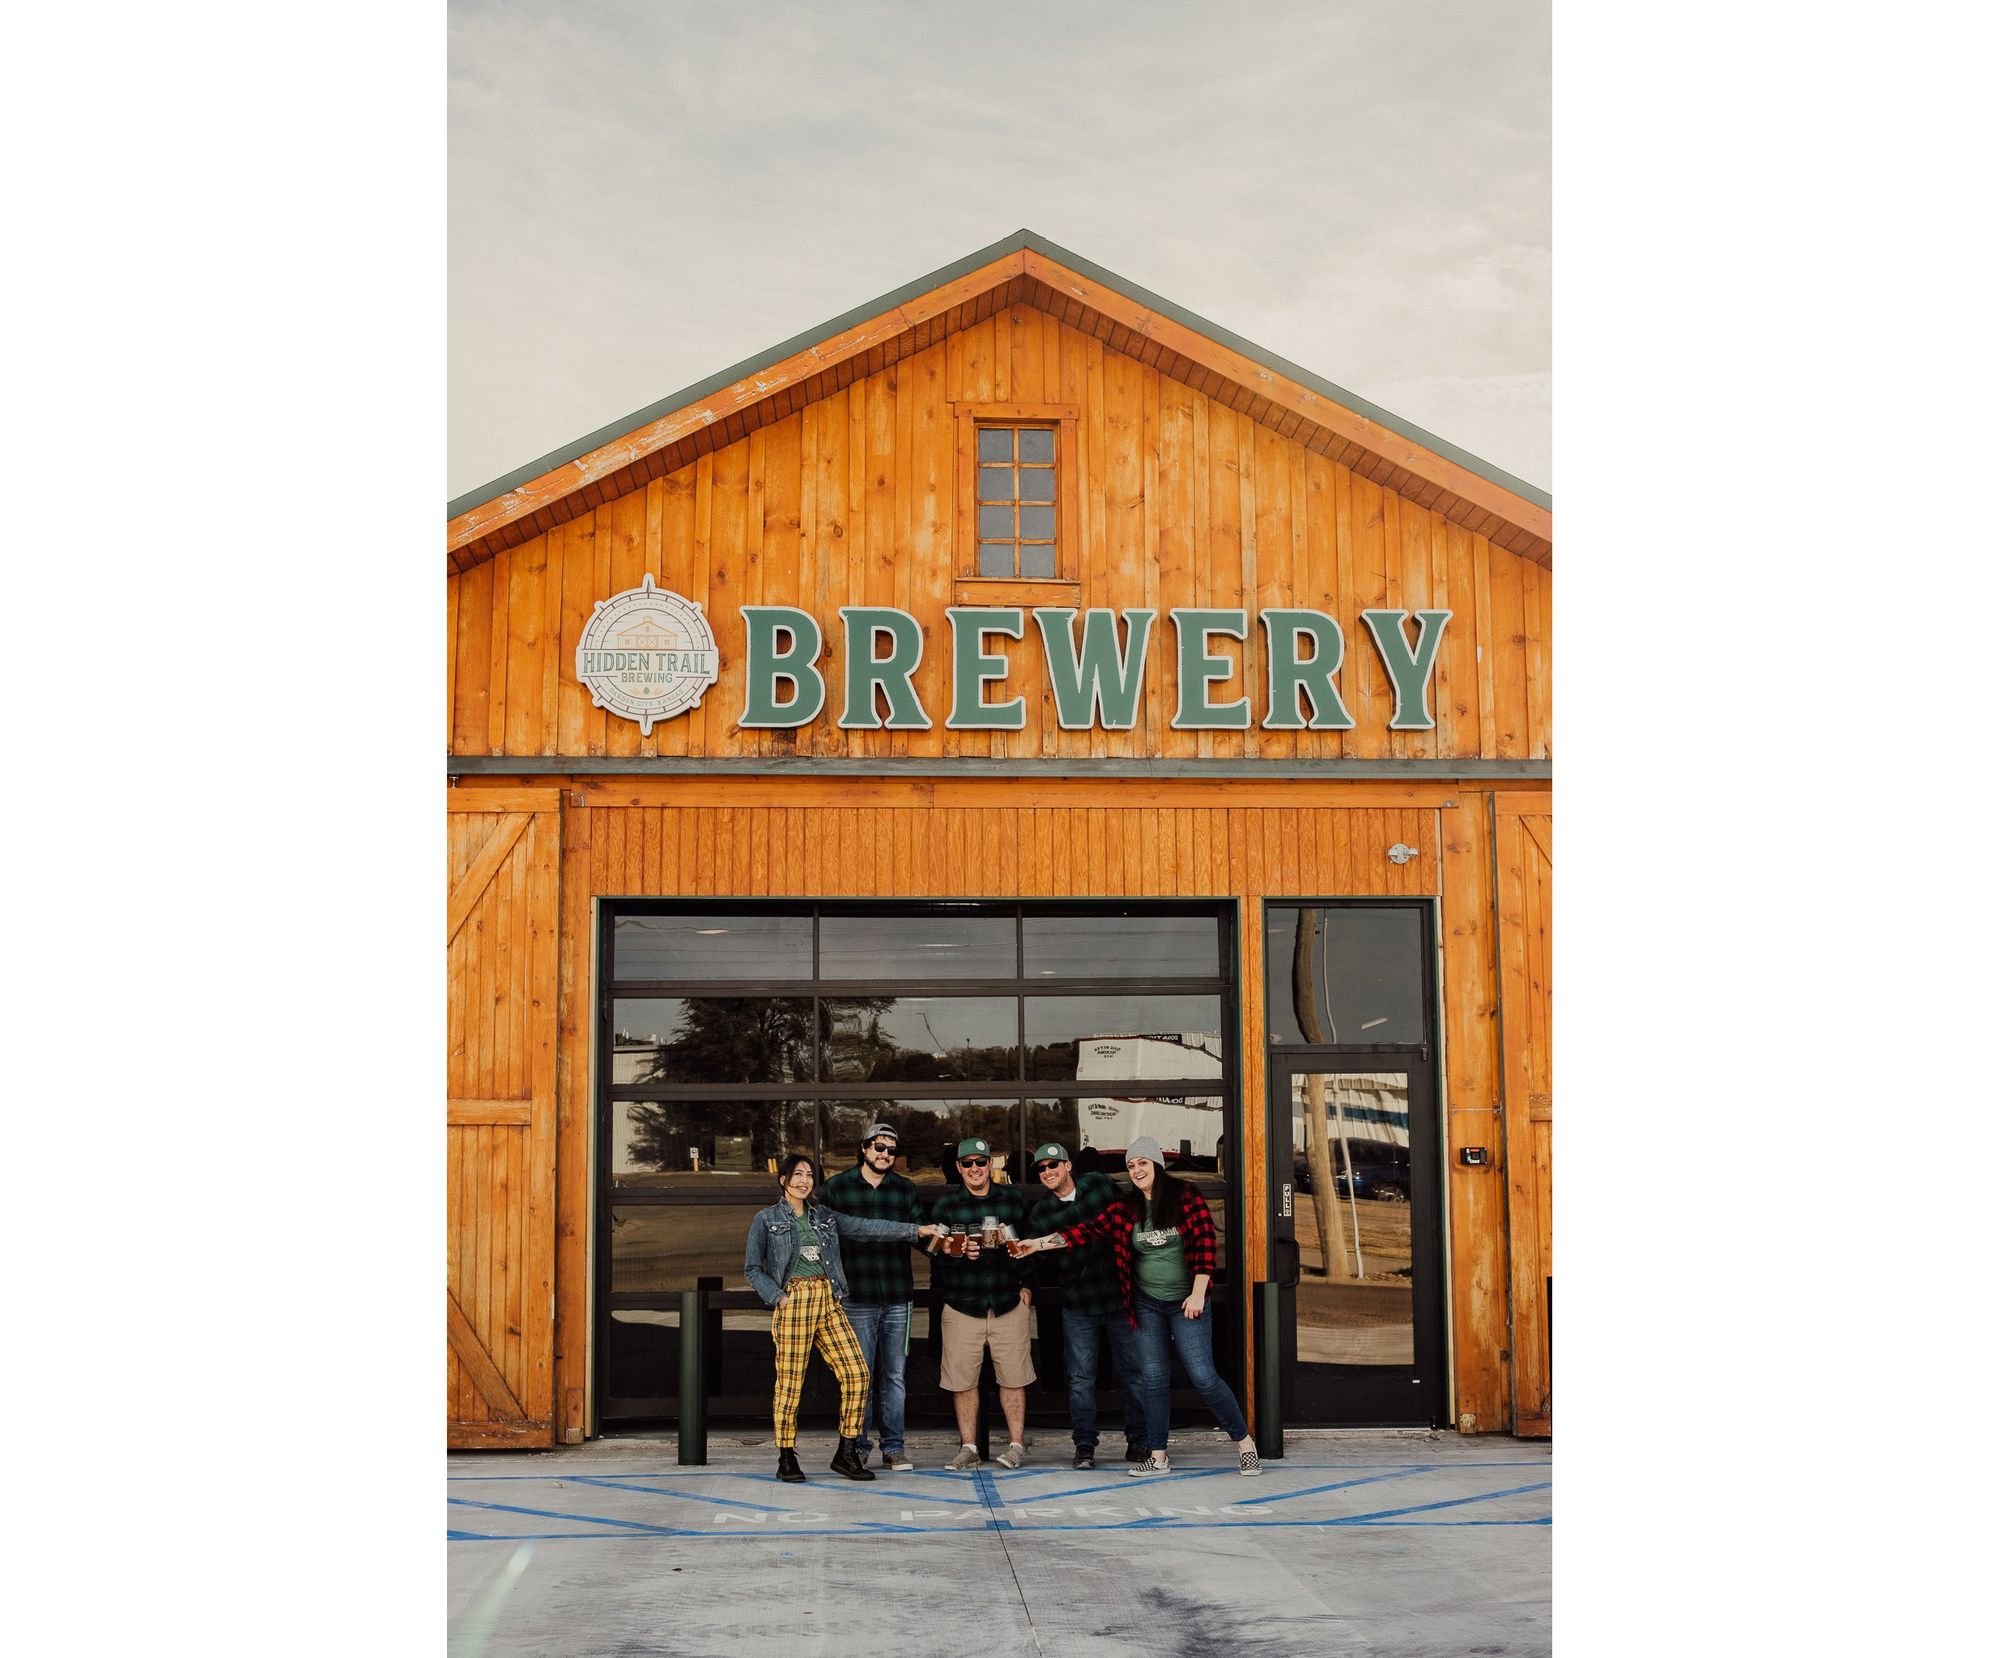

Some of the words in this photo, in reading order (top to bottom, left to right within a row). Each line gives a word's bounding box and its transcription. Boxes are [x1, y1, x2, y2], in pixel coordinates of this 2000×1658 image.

[583, 652, 650, 673] HIDDEN
[656, 653, 711, 675] TRAIL
[739, 605, 1453, 732] BREWERY
[621, 672, 673, 683] BREWING
[609, 688, 635, 706] GARDEN
[657, 688, 685, 706] KANSAS
[713, 1512, 829, 1524] NO
[900, 1505, 1274, 1521] PARKING
